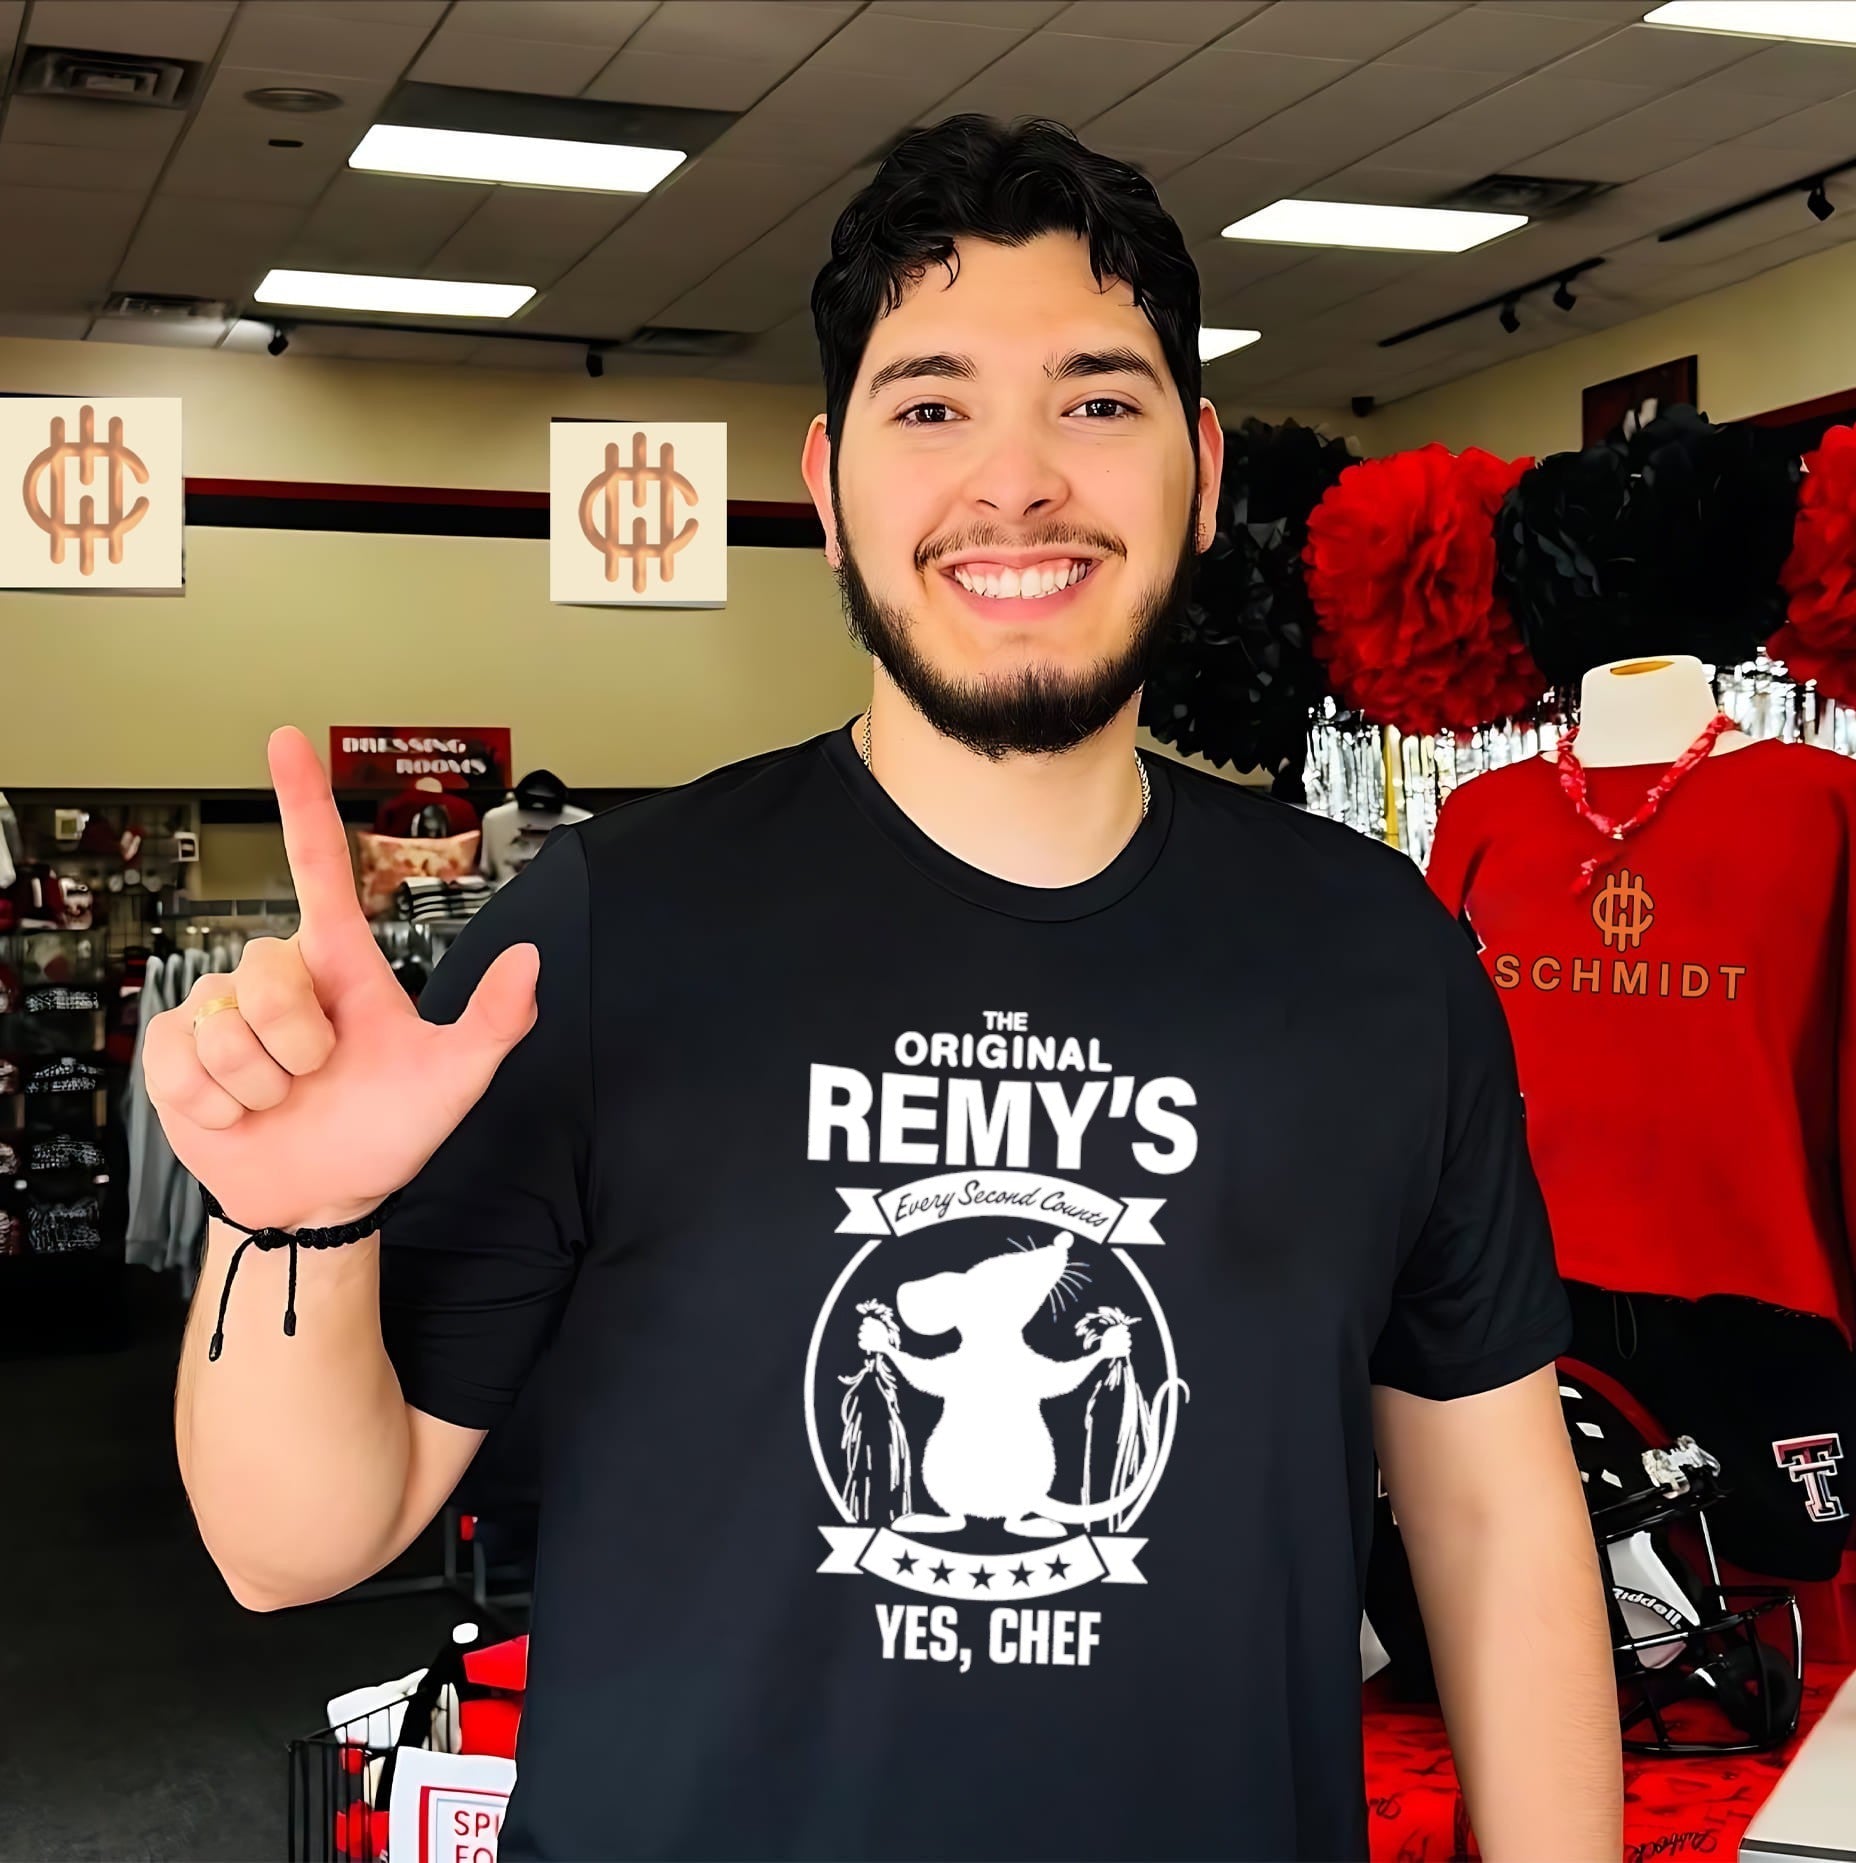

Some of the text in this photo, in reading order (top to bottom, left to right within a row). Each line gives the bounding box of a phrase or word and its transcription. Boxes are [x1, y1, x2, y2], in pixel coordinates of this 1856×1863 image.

[396, 758, 487, 775] ROOMS
[1494, 955, 1747, 1000] SCHMIDT
[983, 1011, 1029, 1032] THE
[894, 1031, 1113, 1072] ORIGINAL
[807, 1063, 1199, 1175] REMY'S
[895, 1179, 1110, 1228] Every Second Counts
[875, 1603, 1102, 1674] YES, CHEF
